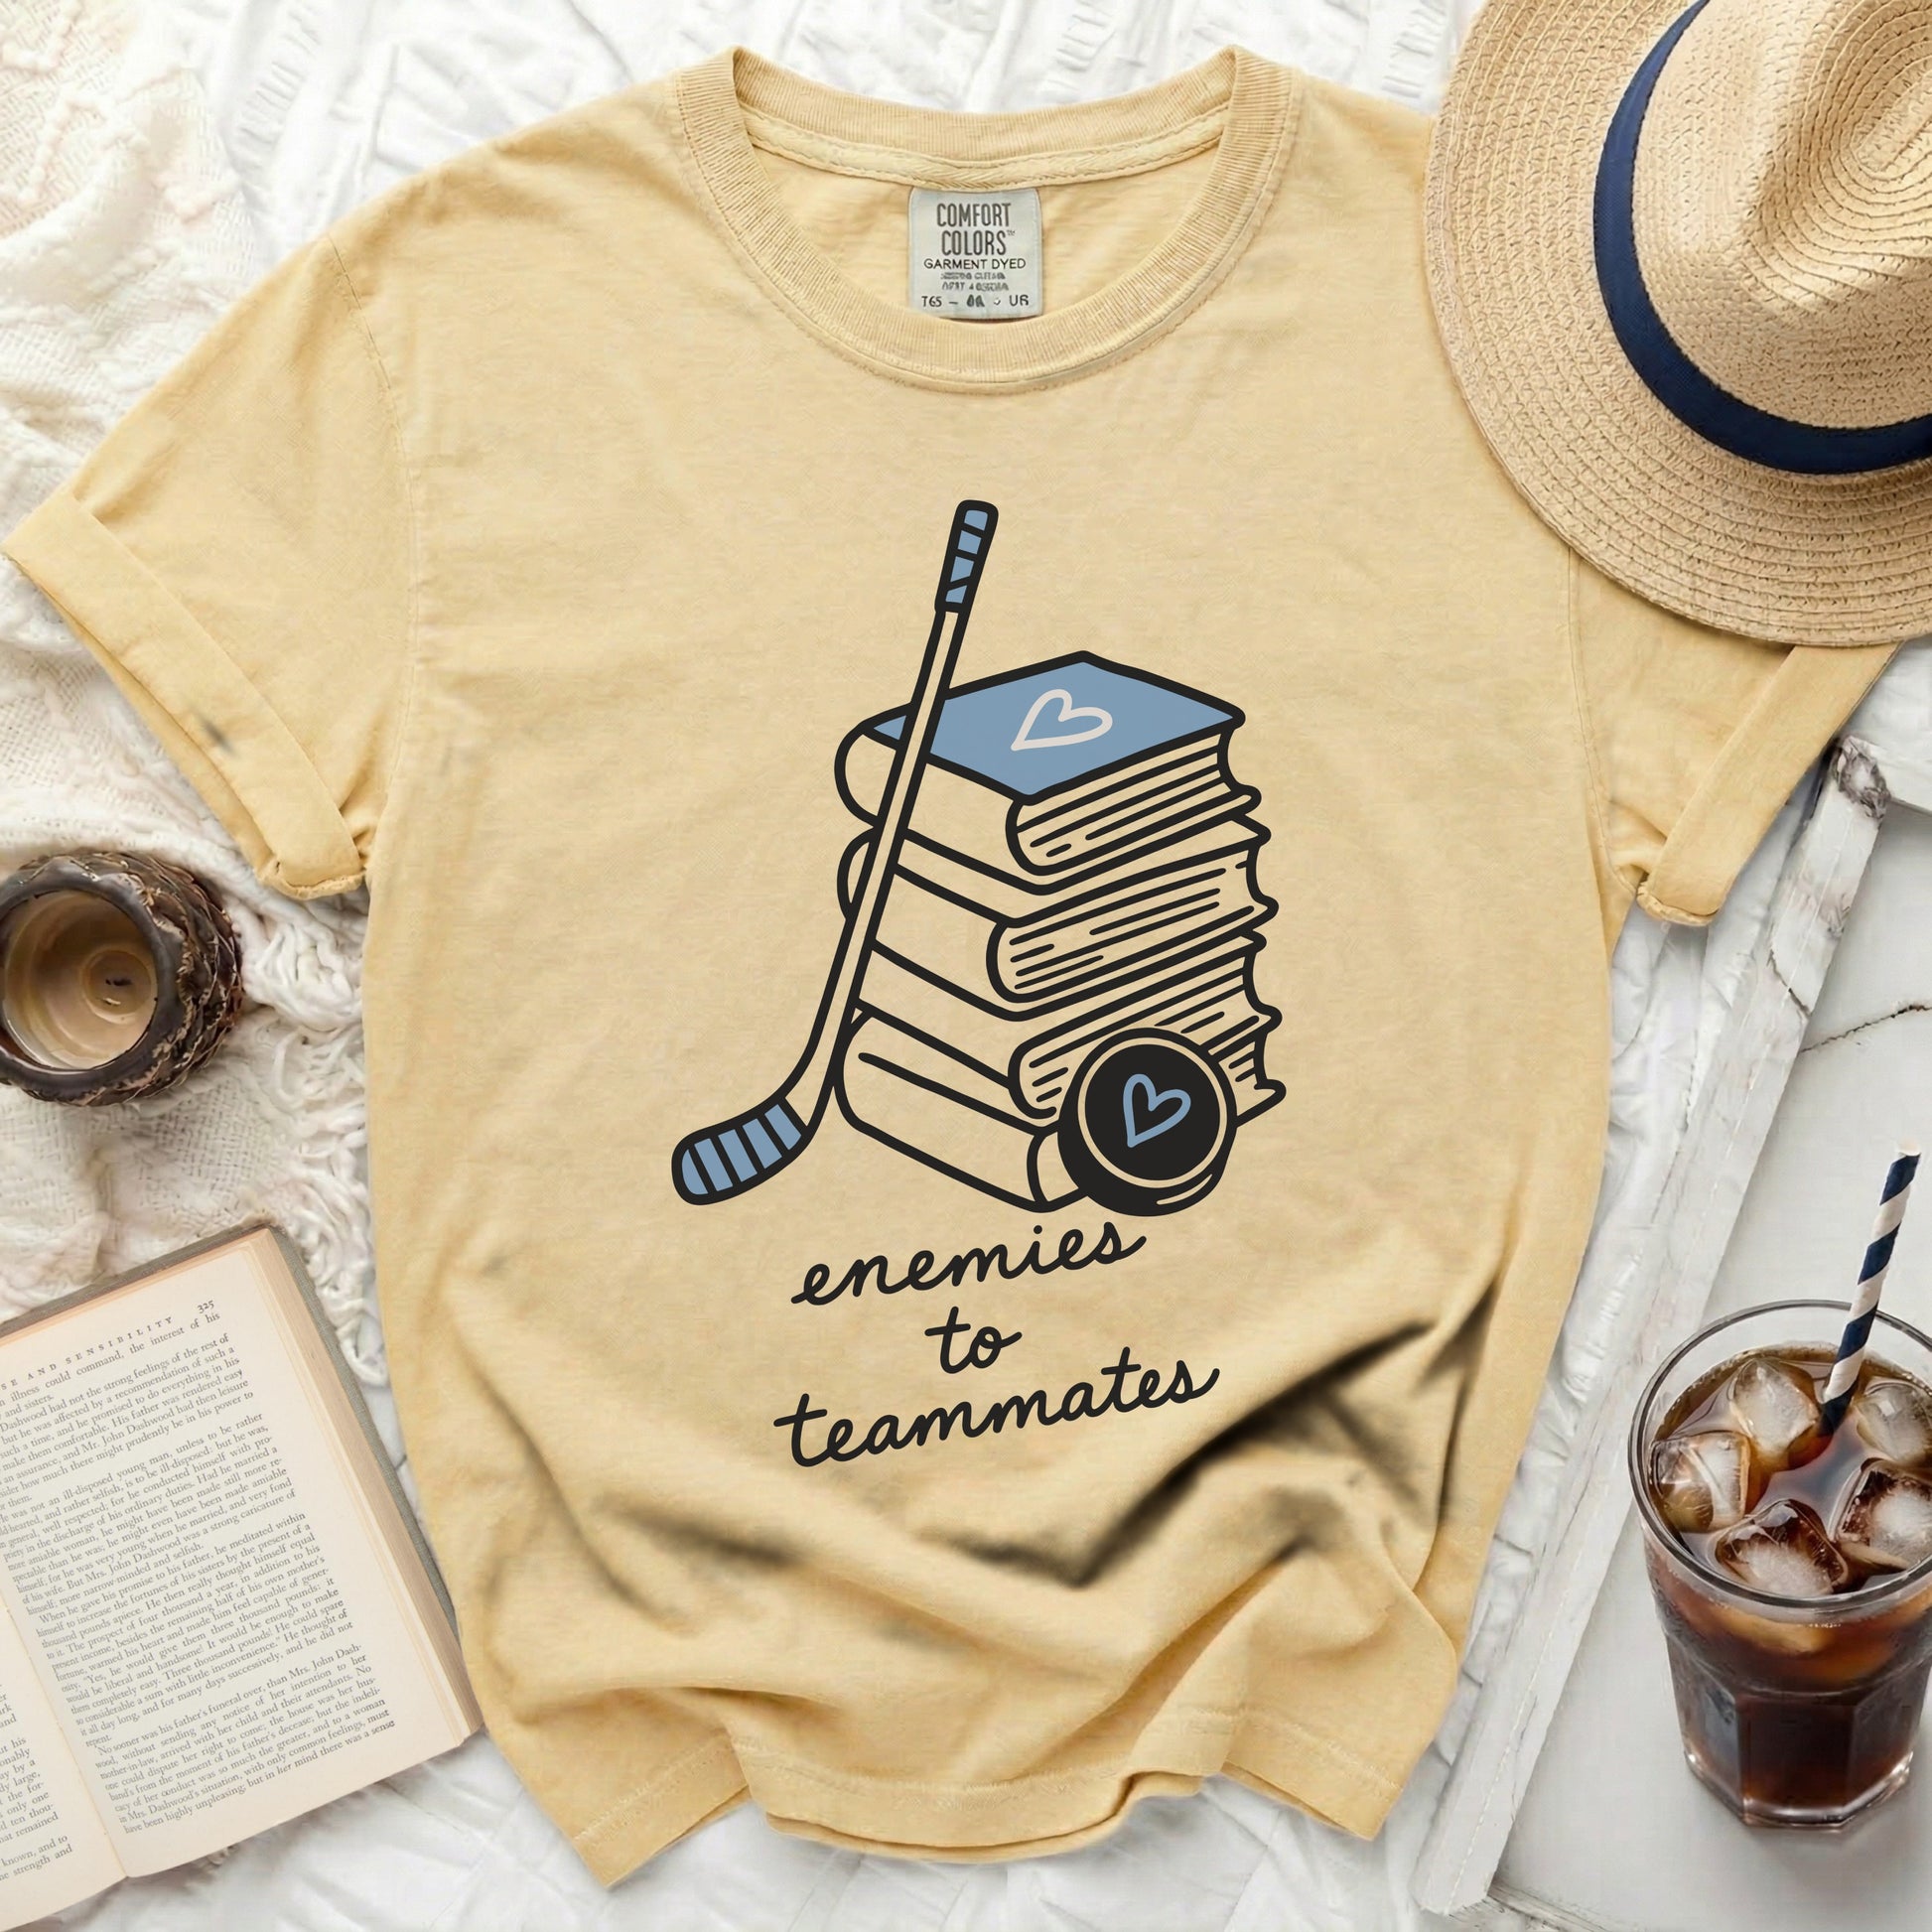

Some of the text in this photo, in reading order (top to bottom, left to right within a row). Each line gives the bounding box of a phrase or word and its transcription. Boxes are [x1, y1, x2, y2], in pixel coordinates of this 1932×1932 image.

[936, 203, 1011, 227] COMFORT
[923, 258, 1027, 270] GARMENT DYED
[921, 296, 942, 308] T65
[791, 1222, 1146, 1305] enemies
[197, 1300, 213, 1313] 325
[9, 1311, 219, 1401] illness could command, the interest of his
[27, 1363, 57, 1380] AND
[66, 1316, 171, 1364] SENSIBILITY
[925, 1307, 1022, 1373] to
[3, 1430, 18, 1444] but
[18, 1429, 32, 1438] he
[33, 1421, 52, 1432] was
[54, 1402, 89, 1424] affected
[89, 1399, 102, 1410] by
[114, 1365, 189, 1399] recommendation
[191, 1355, 202, 1368] of
[204, 1348, 225, 1363] such
[30, 1434, 55, 1449] time,
[56, 1422, 74, 1437] and
[74, 1419, 89, 1429] he
[90, 1398, 133, 1426] promised
[132, 1391, 145, 1405] to
[145, 1389, 159, 1399] do
[161, 1369, 210, 1393] everything
[210, 1364, 222, 1373] in
[222, 1356, 239, 1368] his
[47, 1398, 68, 1413] had
[68, 1393, 84, 1405] not
[85, 1387, 102, 1398] the
[103, 1374, 134, 1392] strong
[133, 1359, 170, 1380] feelings
[171, 1351, 181, 1363] of
[183, 1347, 199, 1358] the
[200, 1339, 217, 1351] rest
[218, 1332, 228, 1343] of
[3, 1368, 242, 1470] make them comfortable. His father was rendered easy
[5, 1394, 54, 1417] and sisters.
[16, 1457, 62, 1482] assurance,
[62, 1446, 80, 1460] and
[80, 1441, 99, 1452] Mr.
[100, 1431, 124, 1445] John
[125, 1407, 175, 1434] Dashwood
[175, 1399, 194, 1414] had
[195, 1393, 216, 1406] then
[216, 1376, 248, 1397] leisure
[773, 1347, 1220, 1467] teammates
[10, 1413, 262, 1519] was not an ill-disposed young man, unless to be rather
[19, 1477, 40, 1490] how
[42, 1462, 69, 1481] much
[69, 1456, 94, 1470] there
[95, 1444, 123, 1460] might
[125, 1423, 169, 1450] prudently
[170, 1419, 184, 1429] be
[184, 1413, 196, 1423] in
[196, 1405, 211, 1418] his
[213, 1396, 241, 1414] power
[7, 1492, 32, 1507] them.
[39, 1609, 67, 1623] When
[65, 1604, 78, 1615] he
[79, 1597, 100, 1612] gave
[100, 1590, 116, 1601] his
[117, 1576, 153, 1598] promise
[165, 1564, 181, 1575] his
[182, 1552, 213, 1571] father,
[213, 1545, 226, 1555] he
[229, 1523, 273, 1549] meditated
[275, 1513, 305, 1529] within
[91, 1686, 136, 1710] completely
[139, 1677, 161, 1691] easy.
[164, 1664, 192, 1680] Three
[194, 1642, 235, 1668] thousand
[236, 1627, 273, 1652] pounds!
[274, 1621, 290, 1633] He
[289, 1607, 318, 1625] could
[319, 1599, 345, 1616] spare
[96, 1643, 360, 1755] No sooner was his father's funeral over, than Mrs. John Dash-
[11, 1736, 26, 1748] his
[11, 1761, 25, 1773] by
[141, 1813, 164, 1828] been
[164, 1800, 193, 1821] highly
[194, 1778, 245, 1809] unpleasing;
[245, 1775, 263, 1787] but
[275, 1759, 291, 1774] her
[294, 1749, 318, 1767] mind
[319, 1741, 343, 1755] there
[344, 1733, 362, 1744] was
[370, 1720, 394, 1734] sense
[6, 1779, 43, 1802] the for-
[6, 1791, 49, 1815] only one
[12, 1770, 40, 1786] large,
[10, 1802, 53, 1826] ten thou-
[15, 1811, 58, 1837] remained
[38, 1838, 56, 1853] and
[57, 1835, 68, 1844] to
[13, 1843, 71, 1875] strength and
